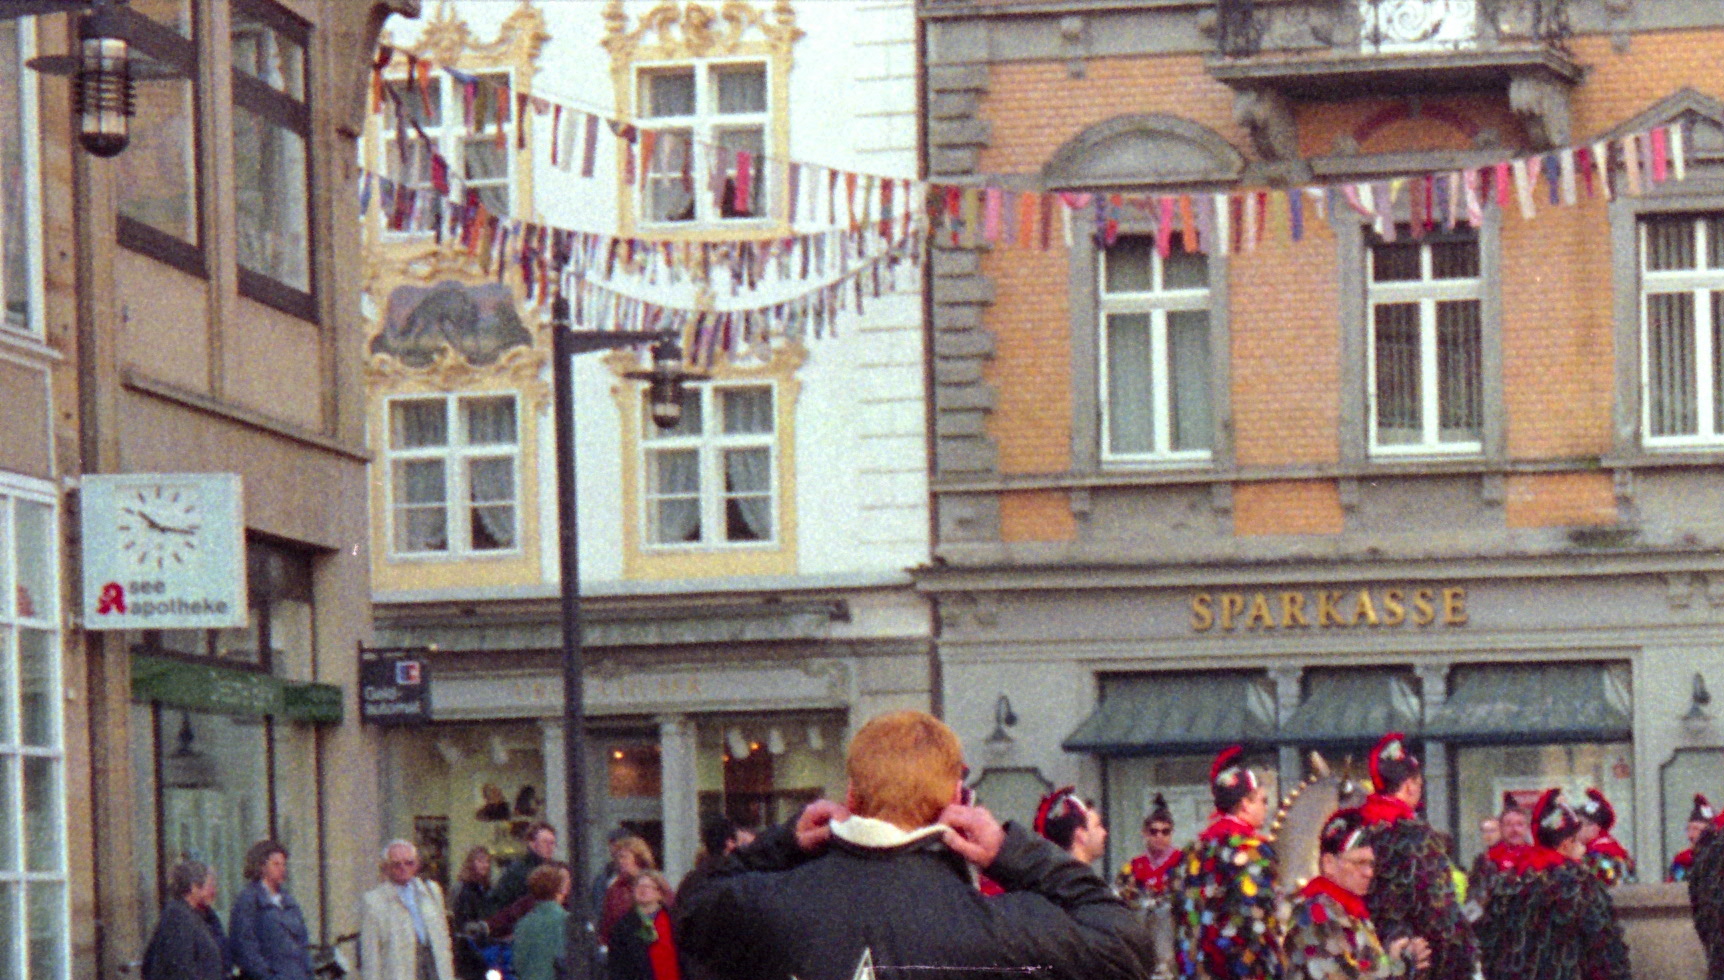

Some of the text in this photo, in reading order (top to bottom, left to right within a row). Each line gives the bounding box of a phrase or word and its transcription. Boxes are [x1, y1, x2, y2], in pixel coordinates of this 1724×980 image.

[130, 581, 166, 595] see
[131, 598, 228, 617] apotheke
[1191, 587, 1469, 630] SPARKASSE
